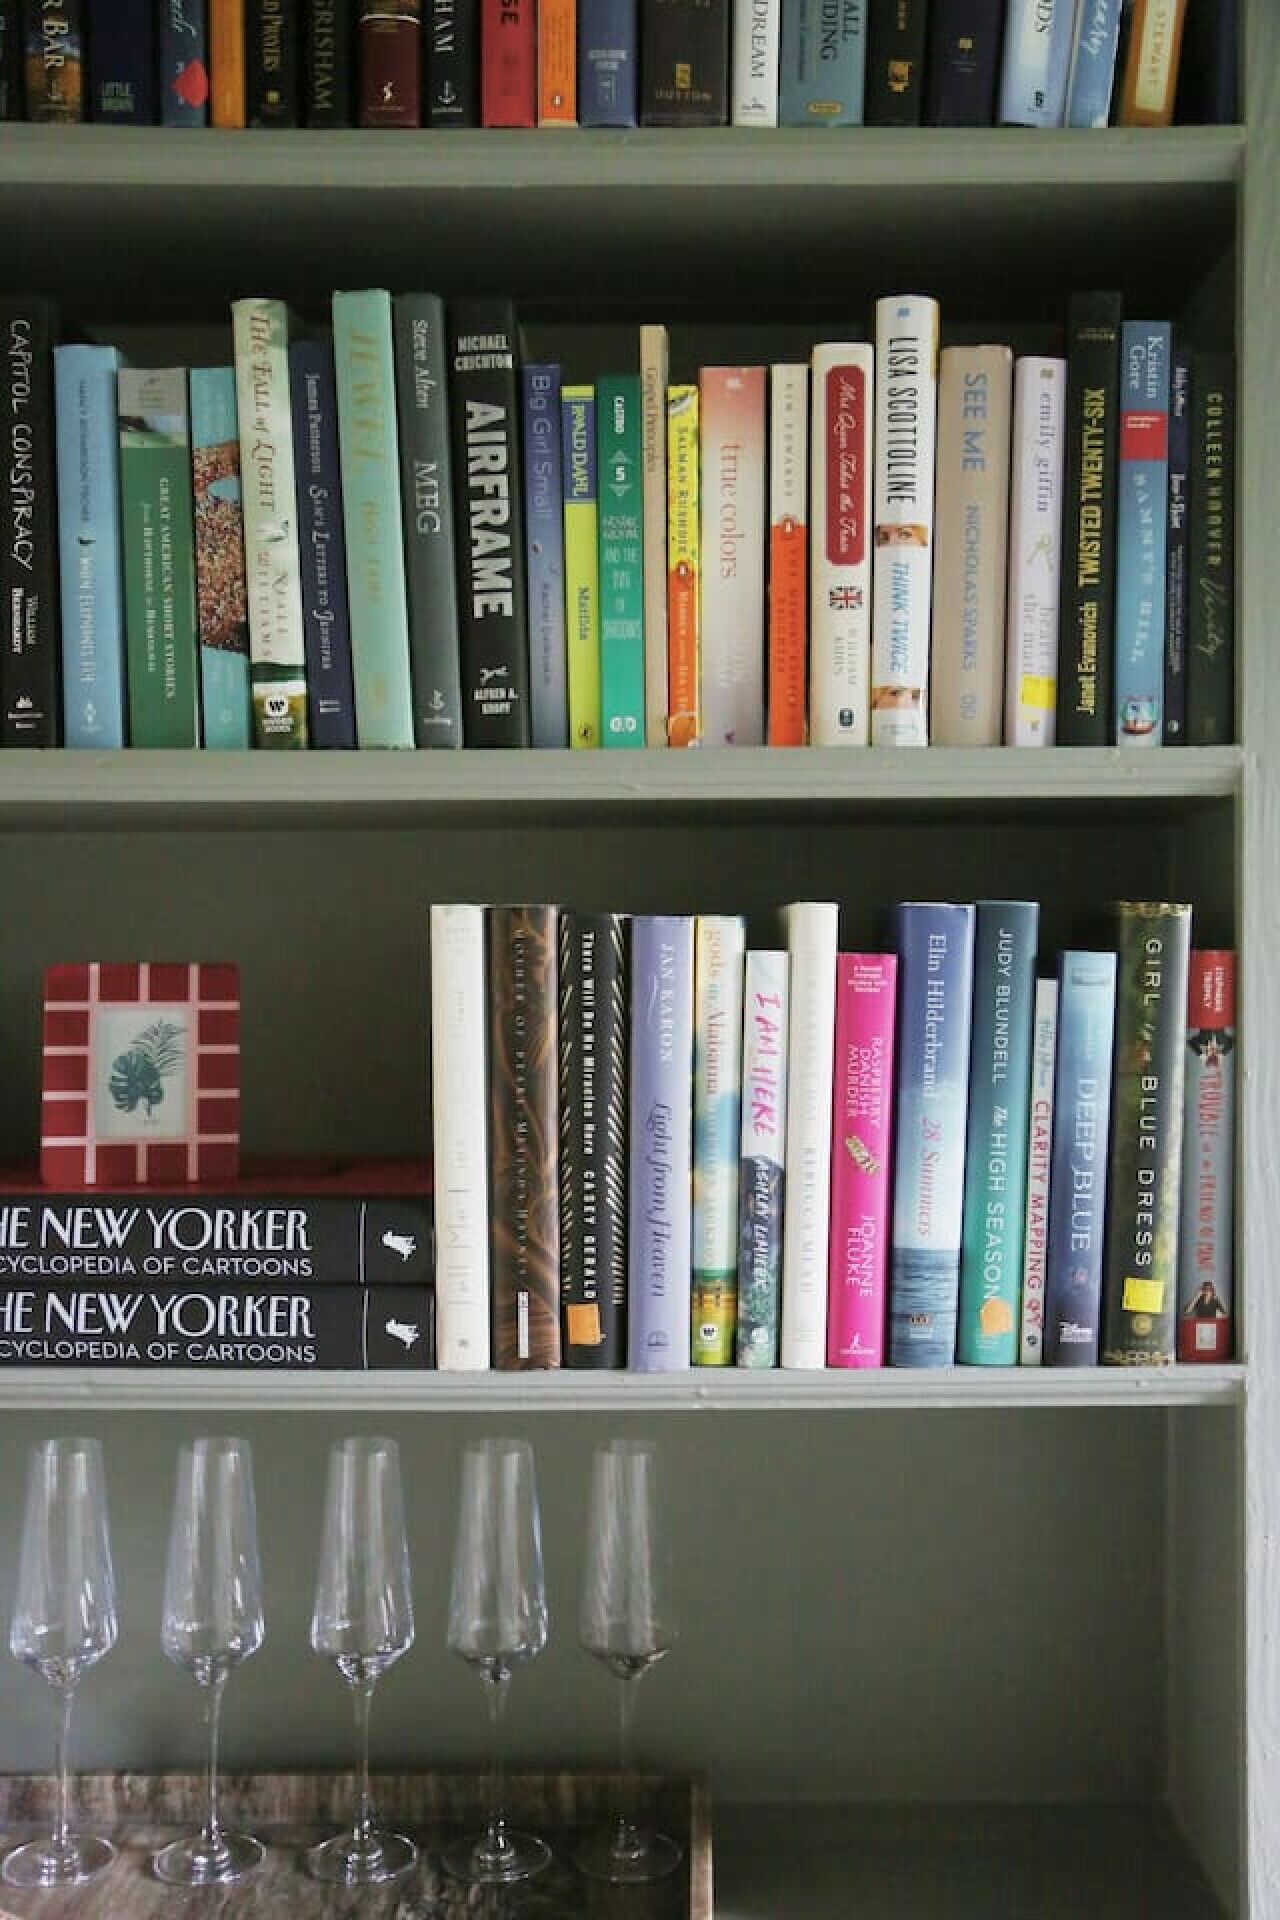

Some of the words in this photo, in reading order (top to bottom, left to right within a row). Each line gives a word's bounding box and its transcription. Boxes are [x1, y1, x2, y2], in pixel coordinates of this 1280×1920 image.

[43, 20, 69, 67] BAR
[9, 319, 33, 413] CAPITOL
[887, 336, 919, 380] LISA
[1128, 345, 1146, 390] Gore
[1146, 335, 1164, 400] Kristin
[529, 374, 554, 410] Big
[962, 371, 987, 421] SEE
[1033, 391, 1056, 449] emily
[533, 416, 554, 455] Girl
[886, 386, 919, 505] SCOTTOLINE
[961, 430, 986, 473] ME
[1081, 386, 1106, 503] TWENTY-SIX
[1206, 392, 1223, 479] COLLEEN
[10, 424, 35, 571] CONSPIRACY
[414, 460, 441, 534] MEG
[532, 460, 554, 516] Small
[571, 451, 590, 497] DAHL
[719, 443, 744, 497] true
[1033, 455, 1056, 514] giffin
[464, 399, 514, 618] AIRFRAME
[1205, 485, 1222, 567] HOOVER
[719, 502, 746, 579] colors
[963, 503, 981, 603] NICHOLAS
[1078, 503, 1102, 588] TWISTED
[890, 560, 912, 612] THINK
[889, 618, 911, 674] TWICE
[960, 606, 979, 673] SPARKS
[580, 931, 598, 971] There
[660, 943, 676, 979] JAN
[926, 934, 948, 971] Elin
[996, 927, 1014, 977] JUDY
[1142, 937, 1164, 1008] GIRL
[580, 979, 598, 1008] Will
[581, 1012, 597, 1030] Be
[756, 992, 782, 1009] I
[581, 1034, 597, 1052] No
[660, 988, 677, 1062] KARON
[706, 1010, 728, 1095] Alabama
[754, 1016, 781, 1058] AM
[921, 978, 947, 1098] Hilderbrand
[990, 984, 1012, 1084] BLUNDELL
[581, 1057, 598, 1118] Miracles
[751, 1066, 779, 1138] HERE
[1138, 1074, 1160, 1151] BLUE
[582, 1123, 598, 1156] Here
[647, 1102, 677, 1156] Light
[921, 1116, 943, 1139] 28
[1033, 1100, 1053, 1183] CLARITY
[1073, 1078, 1100, 1160] DEEP
[646, 1158, 676, 1215] from
[988, 1132, 1009, 1191] HIGH
[583, 1170, 598, 1226] CASEY
[917, 1150, 943, 1237] Summers
[1070, 1163, 1096, 1252] BLUE
[1134, 1167, 1156, 1268] DRESS
[43, 1207, 138, 1250] NEW
[146, 1207, 313, 1252] YORKER
[647, 1215, 676, 1297] Heaven
[846, 1226, 861, 1287] FLUKE
[859, 1215, 878, 1297] JOANNE
[982, 1200, 1006, 1302] SEASON
[1027, 1193, 1046, 1291] MAPPING
[144, 1255, 177, 1276] OF
[184, 1255, 314, 1278] CARTOONS
[582, 1235, 599, 1300] GERALD
[46, 1292, 146, 1334] NEW
[150, 1292, 317, 1340] YORKER
[148, 1340, 181, 1362] OF
[187, 1342, 318, 1364] CARTOONS
